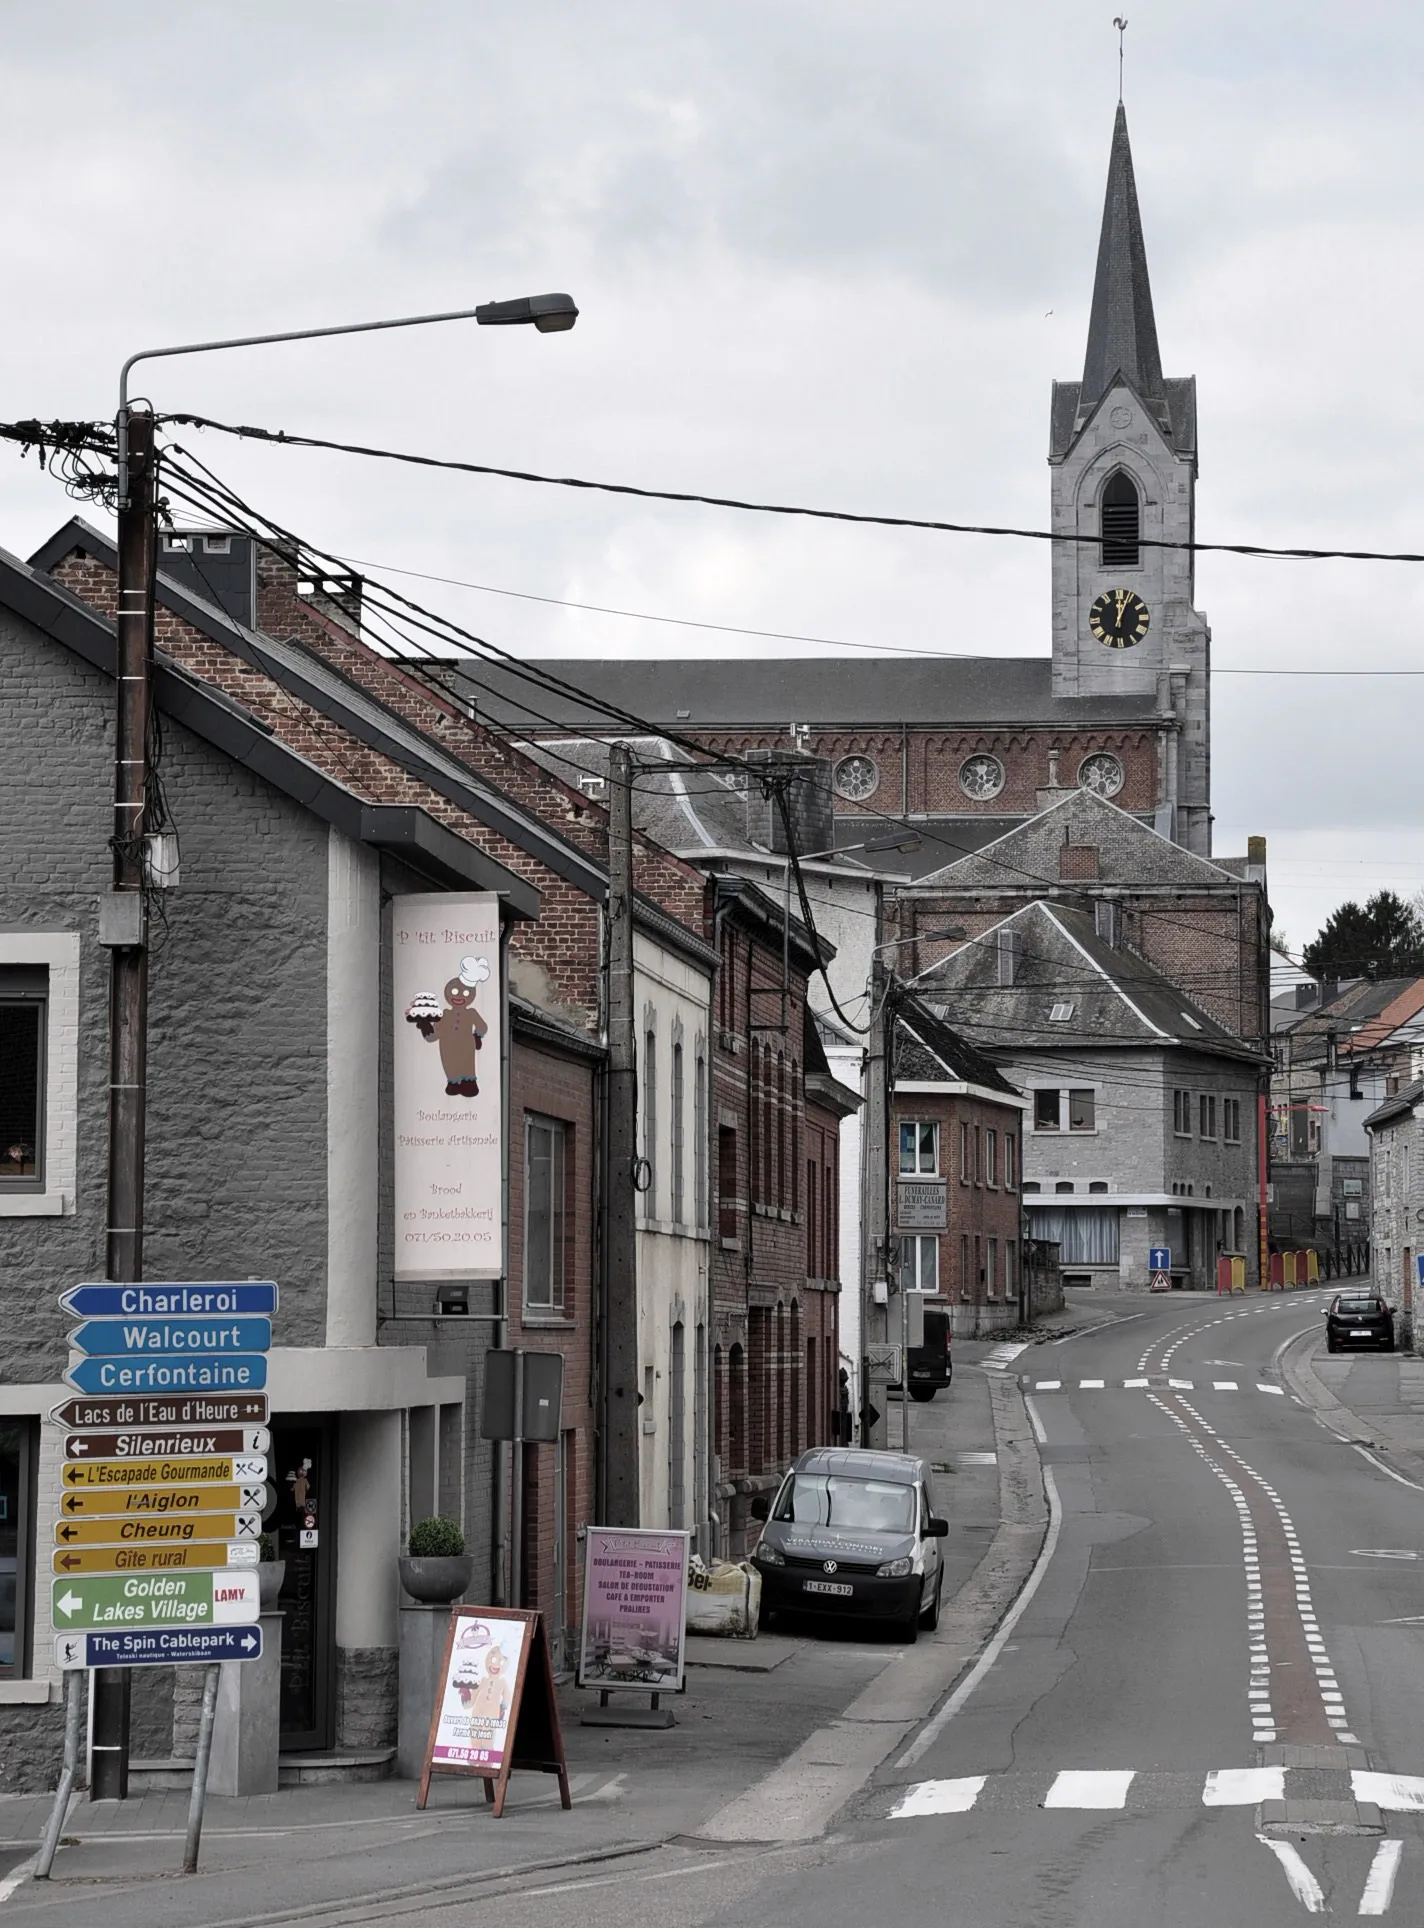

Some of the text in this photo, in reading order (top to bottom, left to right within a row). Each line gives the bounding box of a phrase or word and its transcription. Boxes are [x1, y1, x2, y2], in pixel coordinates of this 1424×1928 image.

[441, 929, 496, 945] Biscuit
[417, 1110, 479, 1123] Boulangerie
[447, 1133, 498, 1146] Artisanale
[429, 1183, 462, 1195] Brood
[404, 1207, 493, 1222] en Banketbakkerij
[404, 1232, 492, 1243] 071/50.20.05
[121, 1289, 237, 1313] Charleroi
[123, 1325, 241, 1348] Walcourt
[100, 1361, 250, 1387] Cerfontaine
[75, 1404, 111, 1425] Lacs
[116, 1403, 134, 1423] de
[115, 1434, 217, 1456] Silenrieux
[87, 1461, 230, 1485] L'Escapade Gourmande
[126, 1493, 200, 1513] l'Aiglon
[120, 1521, 195, 1540] Cheung
[115, 1548, 187, 1569] Gîte rural
[593, 1558, 637, 1568] BOULANGERIE
[645, 1560, 681, 1571] PATISSERIE
[124, 1577, 187, 1598] Golden
[598, 1581, 619, 1590] SALON
[621, 1582, 629, 1590] DE
[809, 1582, 852, 1595] 1-EXX-912
[214, 1588, 245, 1603] LAMY
[630, 1594, 665, 1603] EMPORTER
[93, 1599, 208, 1622] Lakes Village
[619, 1605, 651, 1614] PRALINES
[92, 1632, 235, 1653] The Spin Cablepark
